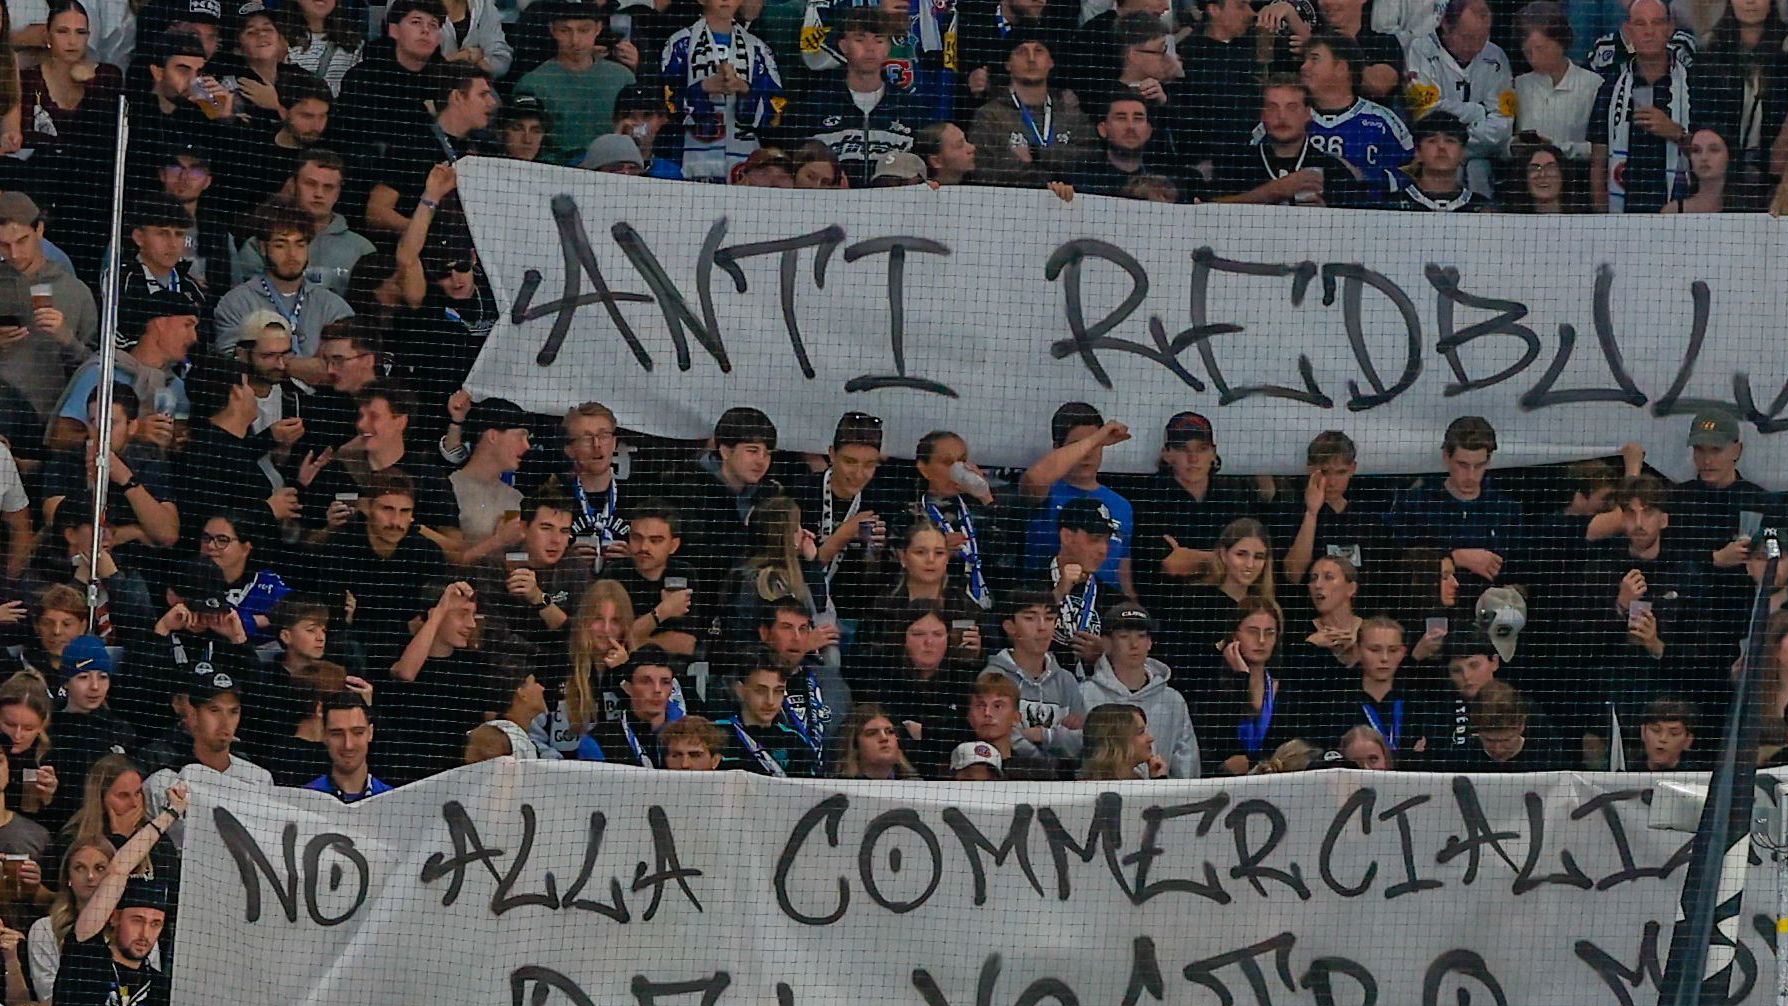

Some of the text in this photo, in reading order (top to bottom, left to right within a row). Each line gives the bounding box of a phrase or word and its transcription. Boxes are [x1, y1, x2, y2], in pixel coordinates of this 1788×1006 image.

[512, 192, 959, 398] ANTI
[212, 805, 369, 926] NO
[420, 800, 704, 924] ALLA
